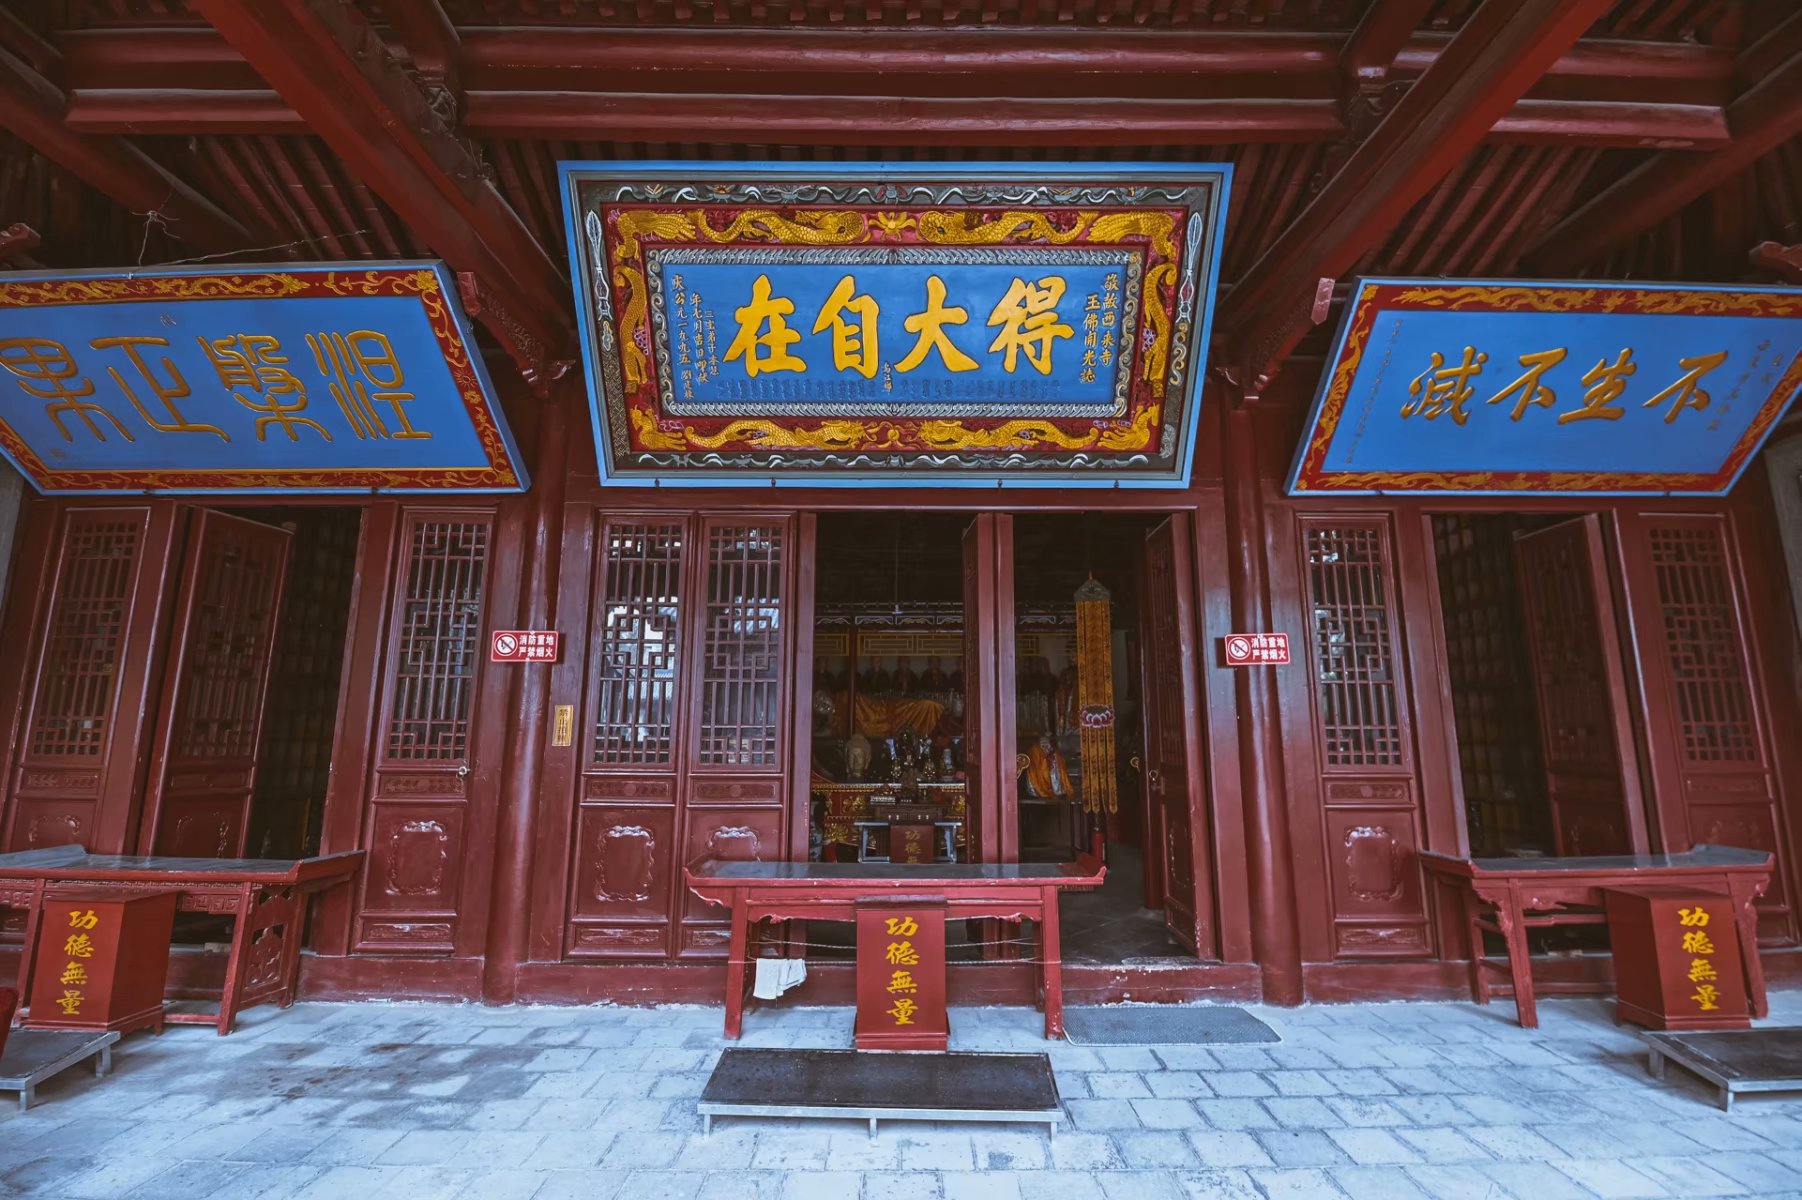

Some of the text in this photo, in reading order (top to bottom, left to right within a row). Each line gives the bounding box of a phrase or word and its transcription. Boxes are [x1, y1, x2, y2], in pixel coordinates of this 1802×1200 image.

[519, 634, 554, 646] 消防重地
[1251, 637, 1285, 648] 消防重地
[518, 647, 553, 658] 严禁烟火
[1252, 649, 1286, 660] 严禁烟火
[56, 909, 98, 1015] 功德無量
[1677, 907, 1721, 1011] 功德無量
[886, 916, 918, 1025] 功德無量
